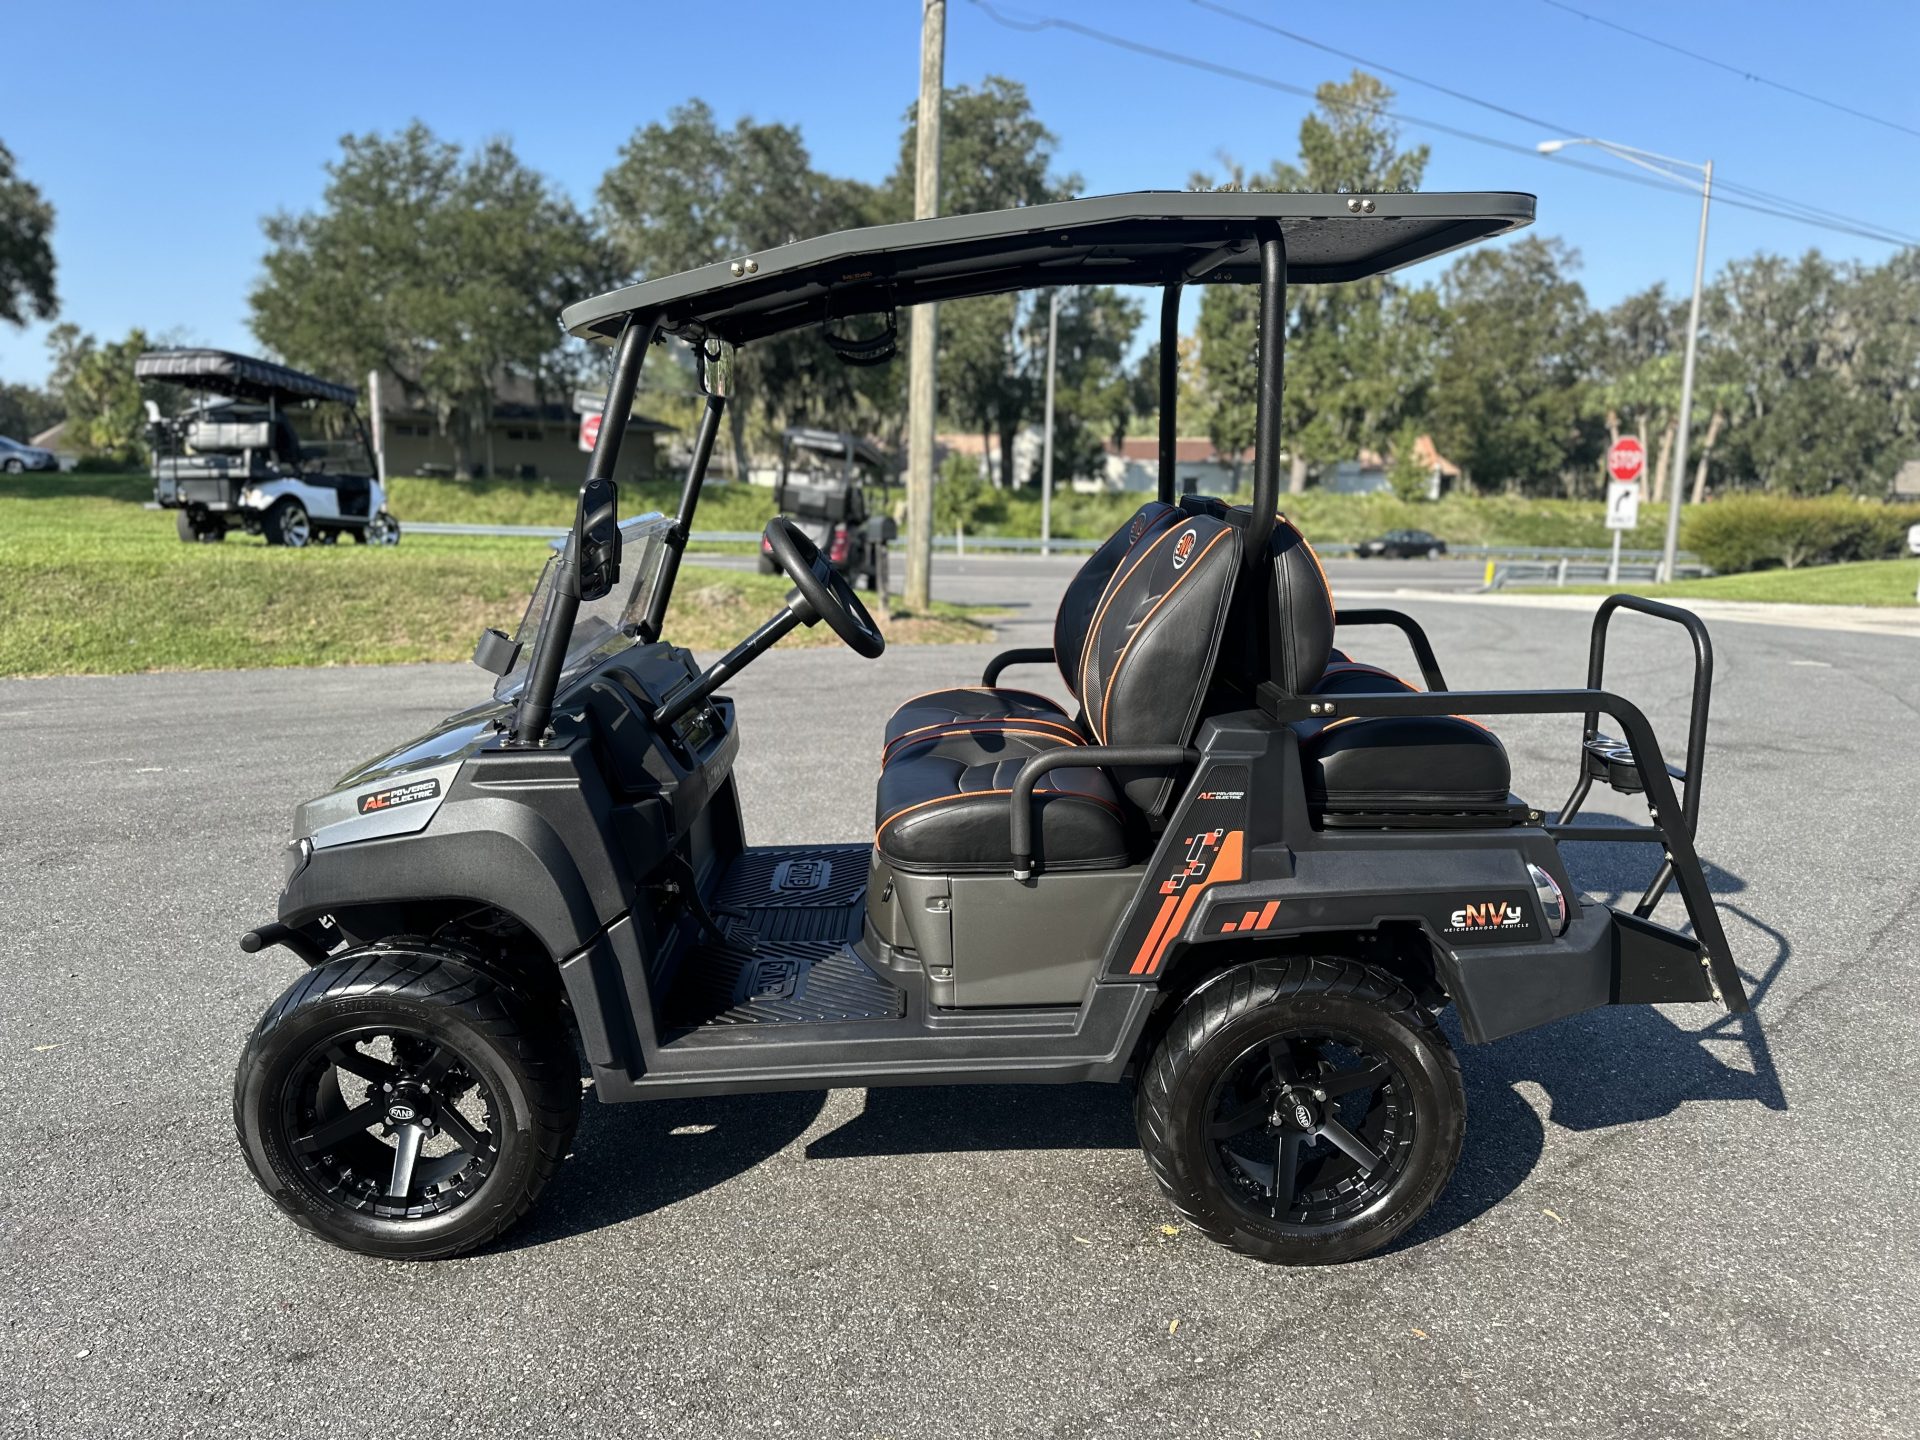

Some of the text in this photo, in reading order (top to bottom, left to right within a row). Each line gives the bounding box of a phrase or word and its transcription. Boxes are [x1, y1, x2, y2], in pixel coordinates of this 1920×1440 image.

[1611, 450, 1642, 469] STOP
[391, 781, 436, 798] POWERED
[391, 789, 434, 805] ELECTRIC
[1197, 792, 1217, 800] AC
[363, 792, 391, 811] AC
[1443, 925, 1498, 933] NEIGHBORHOOD
